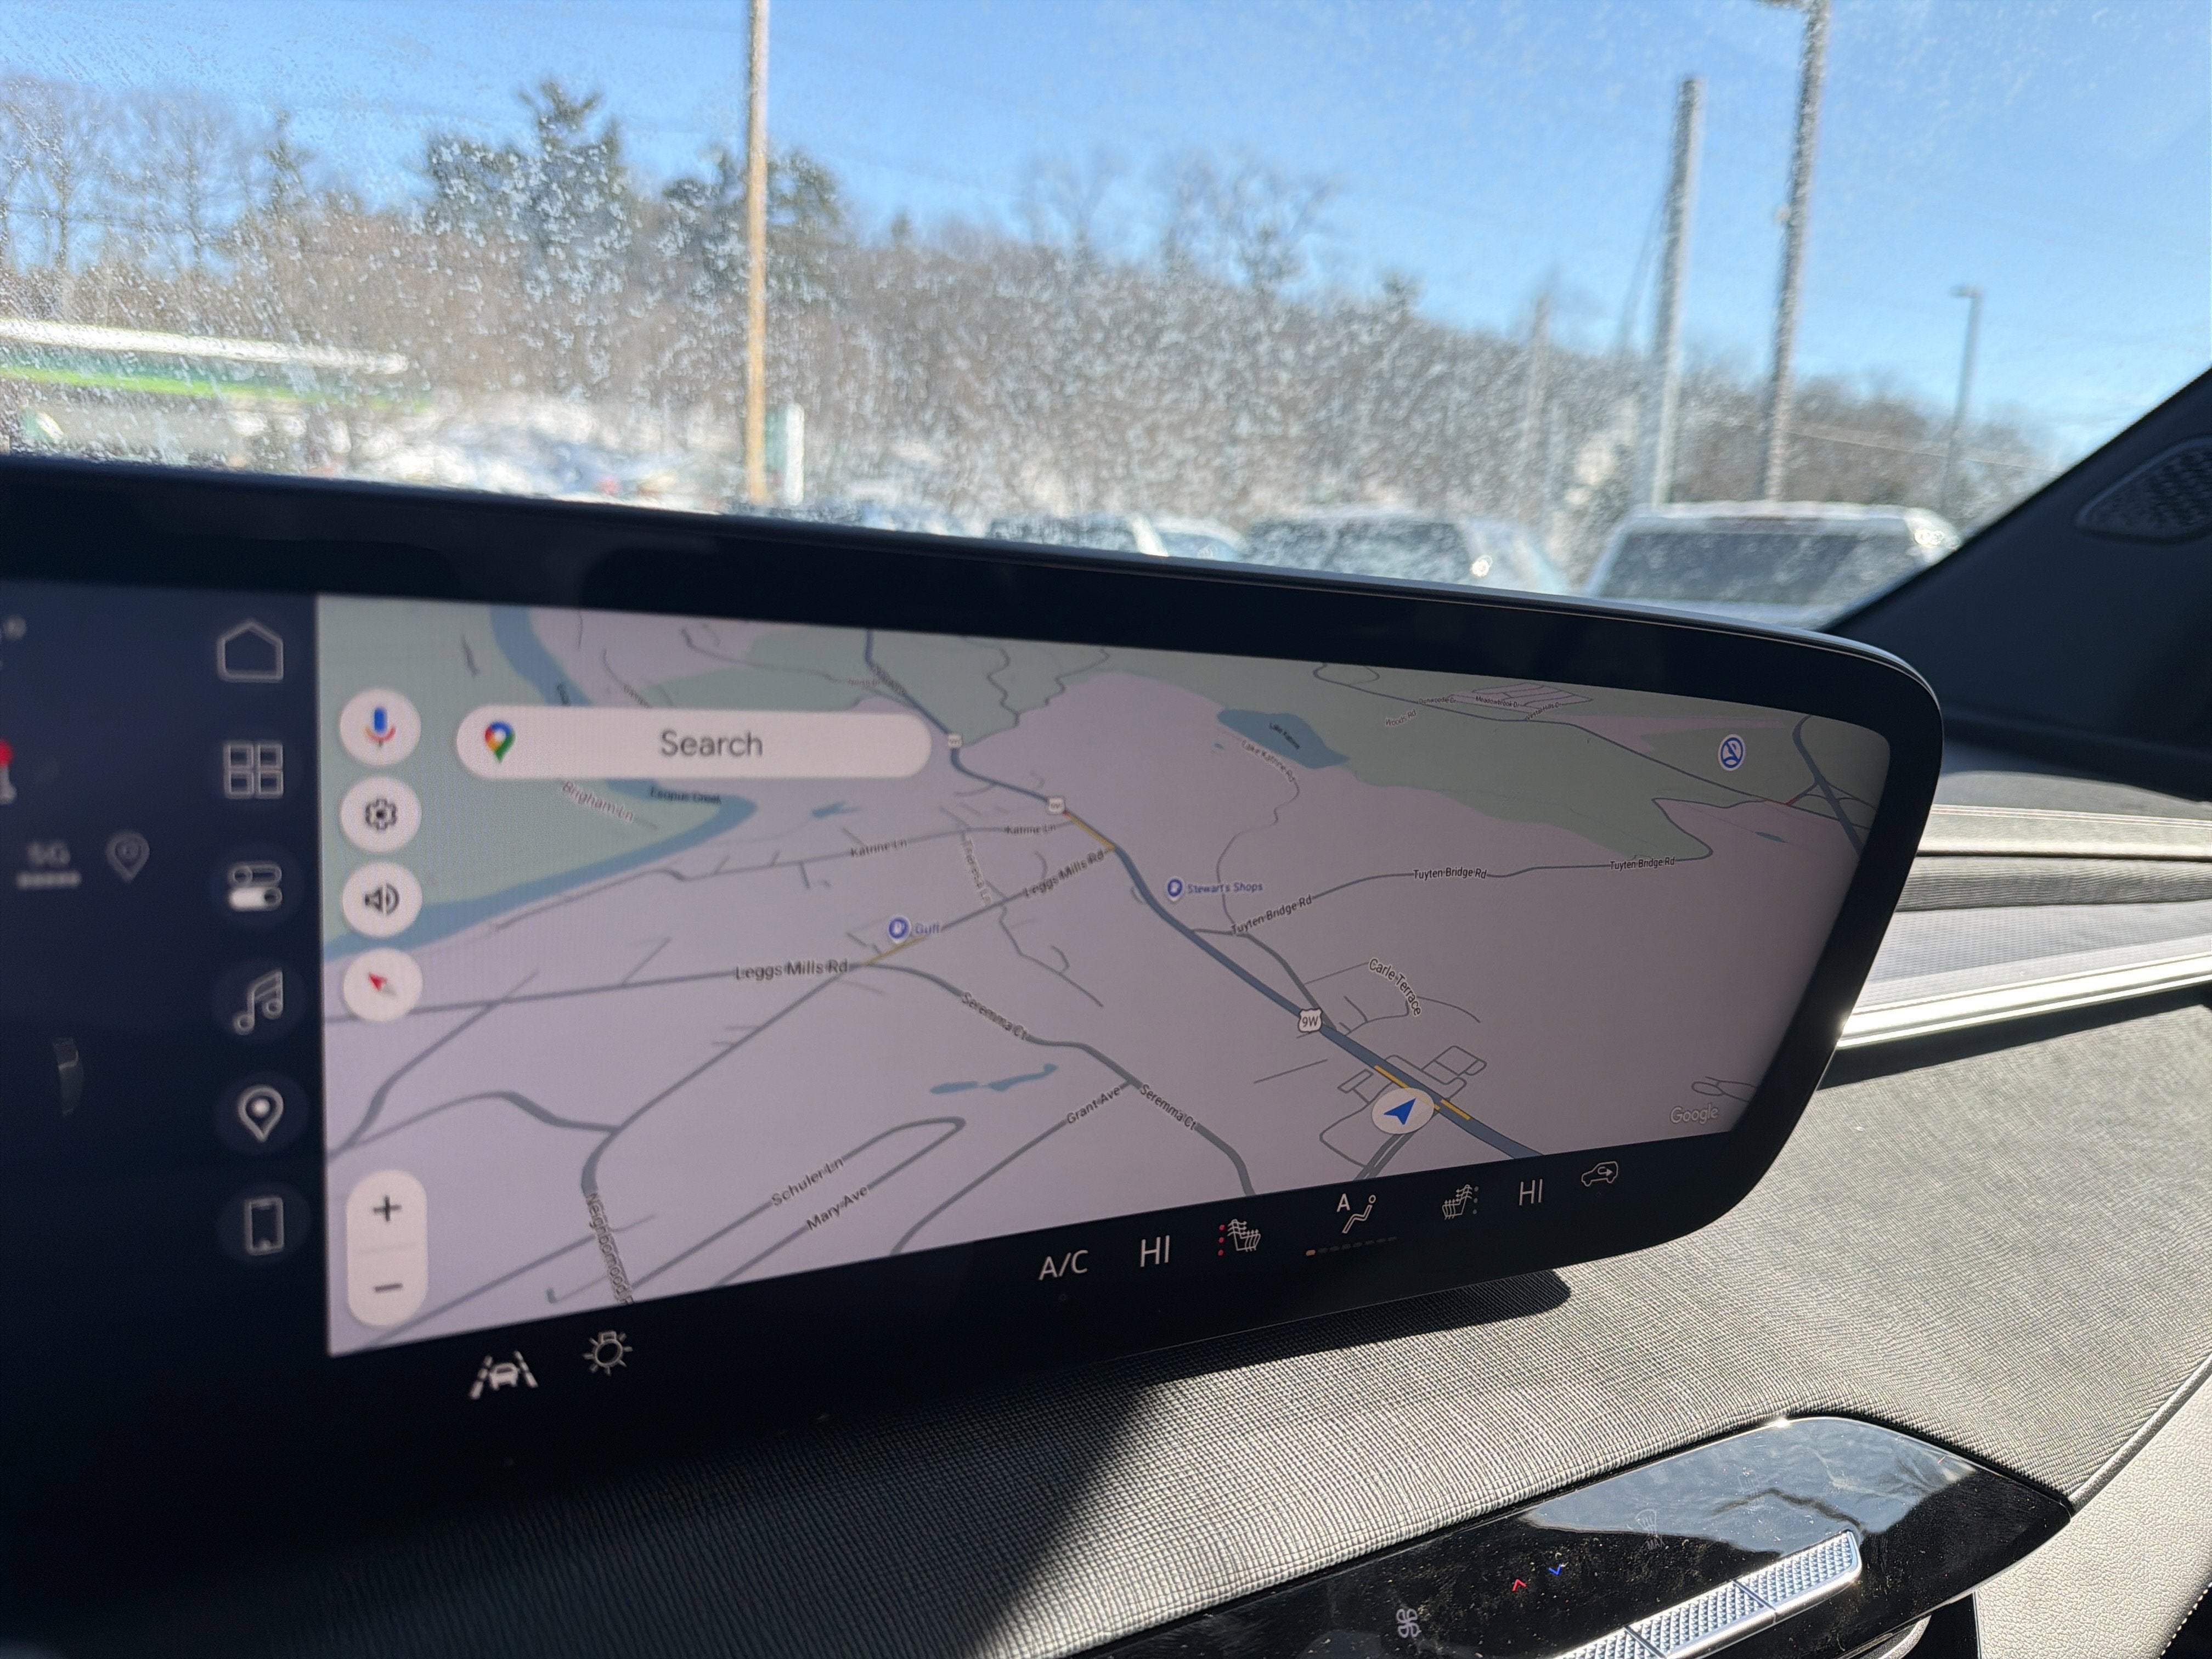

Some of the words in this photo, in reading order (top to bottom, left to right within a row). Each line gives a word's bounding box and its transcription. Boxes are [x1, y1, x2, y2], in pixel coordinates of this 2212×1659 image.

[1475, 696, 1513, 707] Meadowbrook
[1543, 704, 1555, 713] Hills
[1385, 715, 1407, 726] Woods
[1408, 709, 1417, 719] Rd
[661, 730, 764, 758] Search
[562, 781, 616, 814] Brigham
[1023, 877, 1059, 897] Leggs
[1059, 861, 1088, 880] Mills
[1087, 848, 1104, 864] Rd
[1413, 869, 1444, 881] Tuyten
[1446, 868, 1474, 879] Bridge
[1475, 868, 1487, 879] Rd
[1610, 860, 1636, 872] Tuyten
[1638, 859, 1663, 870] Bridge
[1665, 857, 1675, 867] Rd
[1234, 882, 1264, 893] Shops
[1231, 915, 1264, 934] Tuyten
[1265, 902, 1297, 921] Bridge
[1298, 894, 1313, 907] Rd
[736, 964, 783, 981] Leggs
[786, 960, 823, 976] Mills
[827, 959, 849, 974] Rd
[1369, 958, 1395, 981] Carle
[1396, 973, 1421, 1017] Terrace
[962, 991, 1013, 1031] Seremma
[1013, 1024, 1028, 1041] Ct
[1302, 1015, 1318, 1027] 9W
[1066, 1100, 1098, 1124] Grant
[1099, 1086, 1120, 1104] Ave
[1141, 1084, 1185, 1122] Seremma
[1184, 1116, 1197, 1131] Ct
[1670, 1103, 1718, 1124] Google
[771, 1169, 823, 1206] Schuler
[825, 1158, 844, 1175] Ln
[1519, 1178, 1543, 1206] HI
[806, 1203, 840, 1231] Mary
[844, 1186, 868, 1207] Ave
[1336, 1193, 1351, 1212] A
[1039, 1249, 1088, 1280] A/C
[1140, 1235, 1171, 1267] HI
